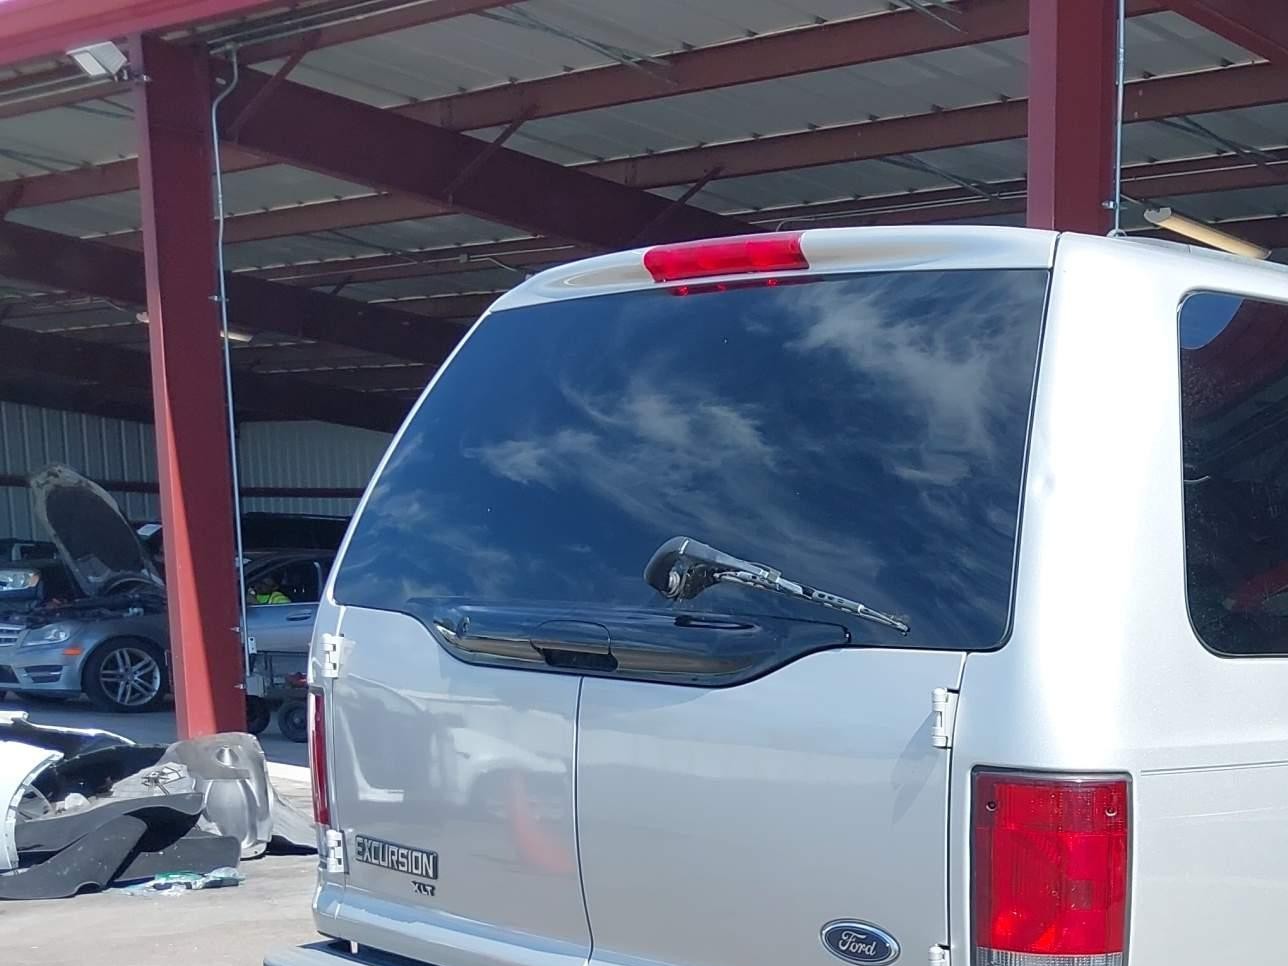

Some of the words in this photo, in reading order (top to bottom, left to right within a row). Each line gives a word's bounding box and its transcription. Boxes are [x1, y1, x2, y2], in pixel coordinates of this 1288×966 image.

[355, 836, 436, 878] EXCURSION
[411, 881, 435, 896] XLT
[838, 930, 877, 956] Ford
